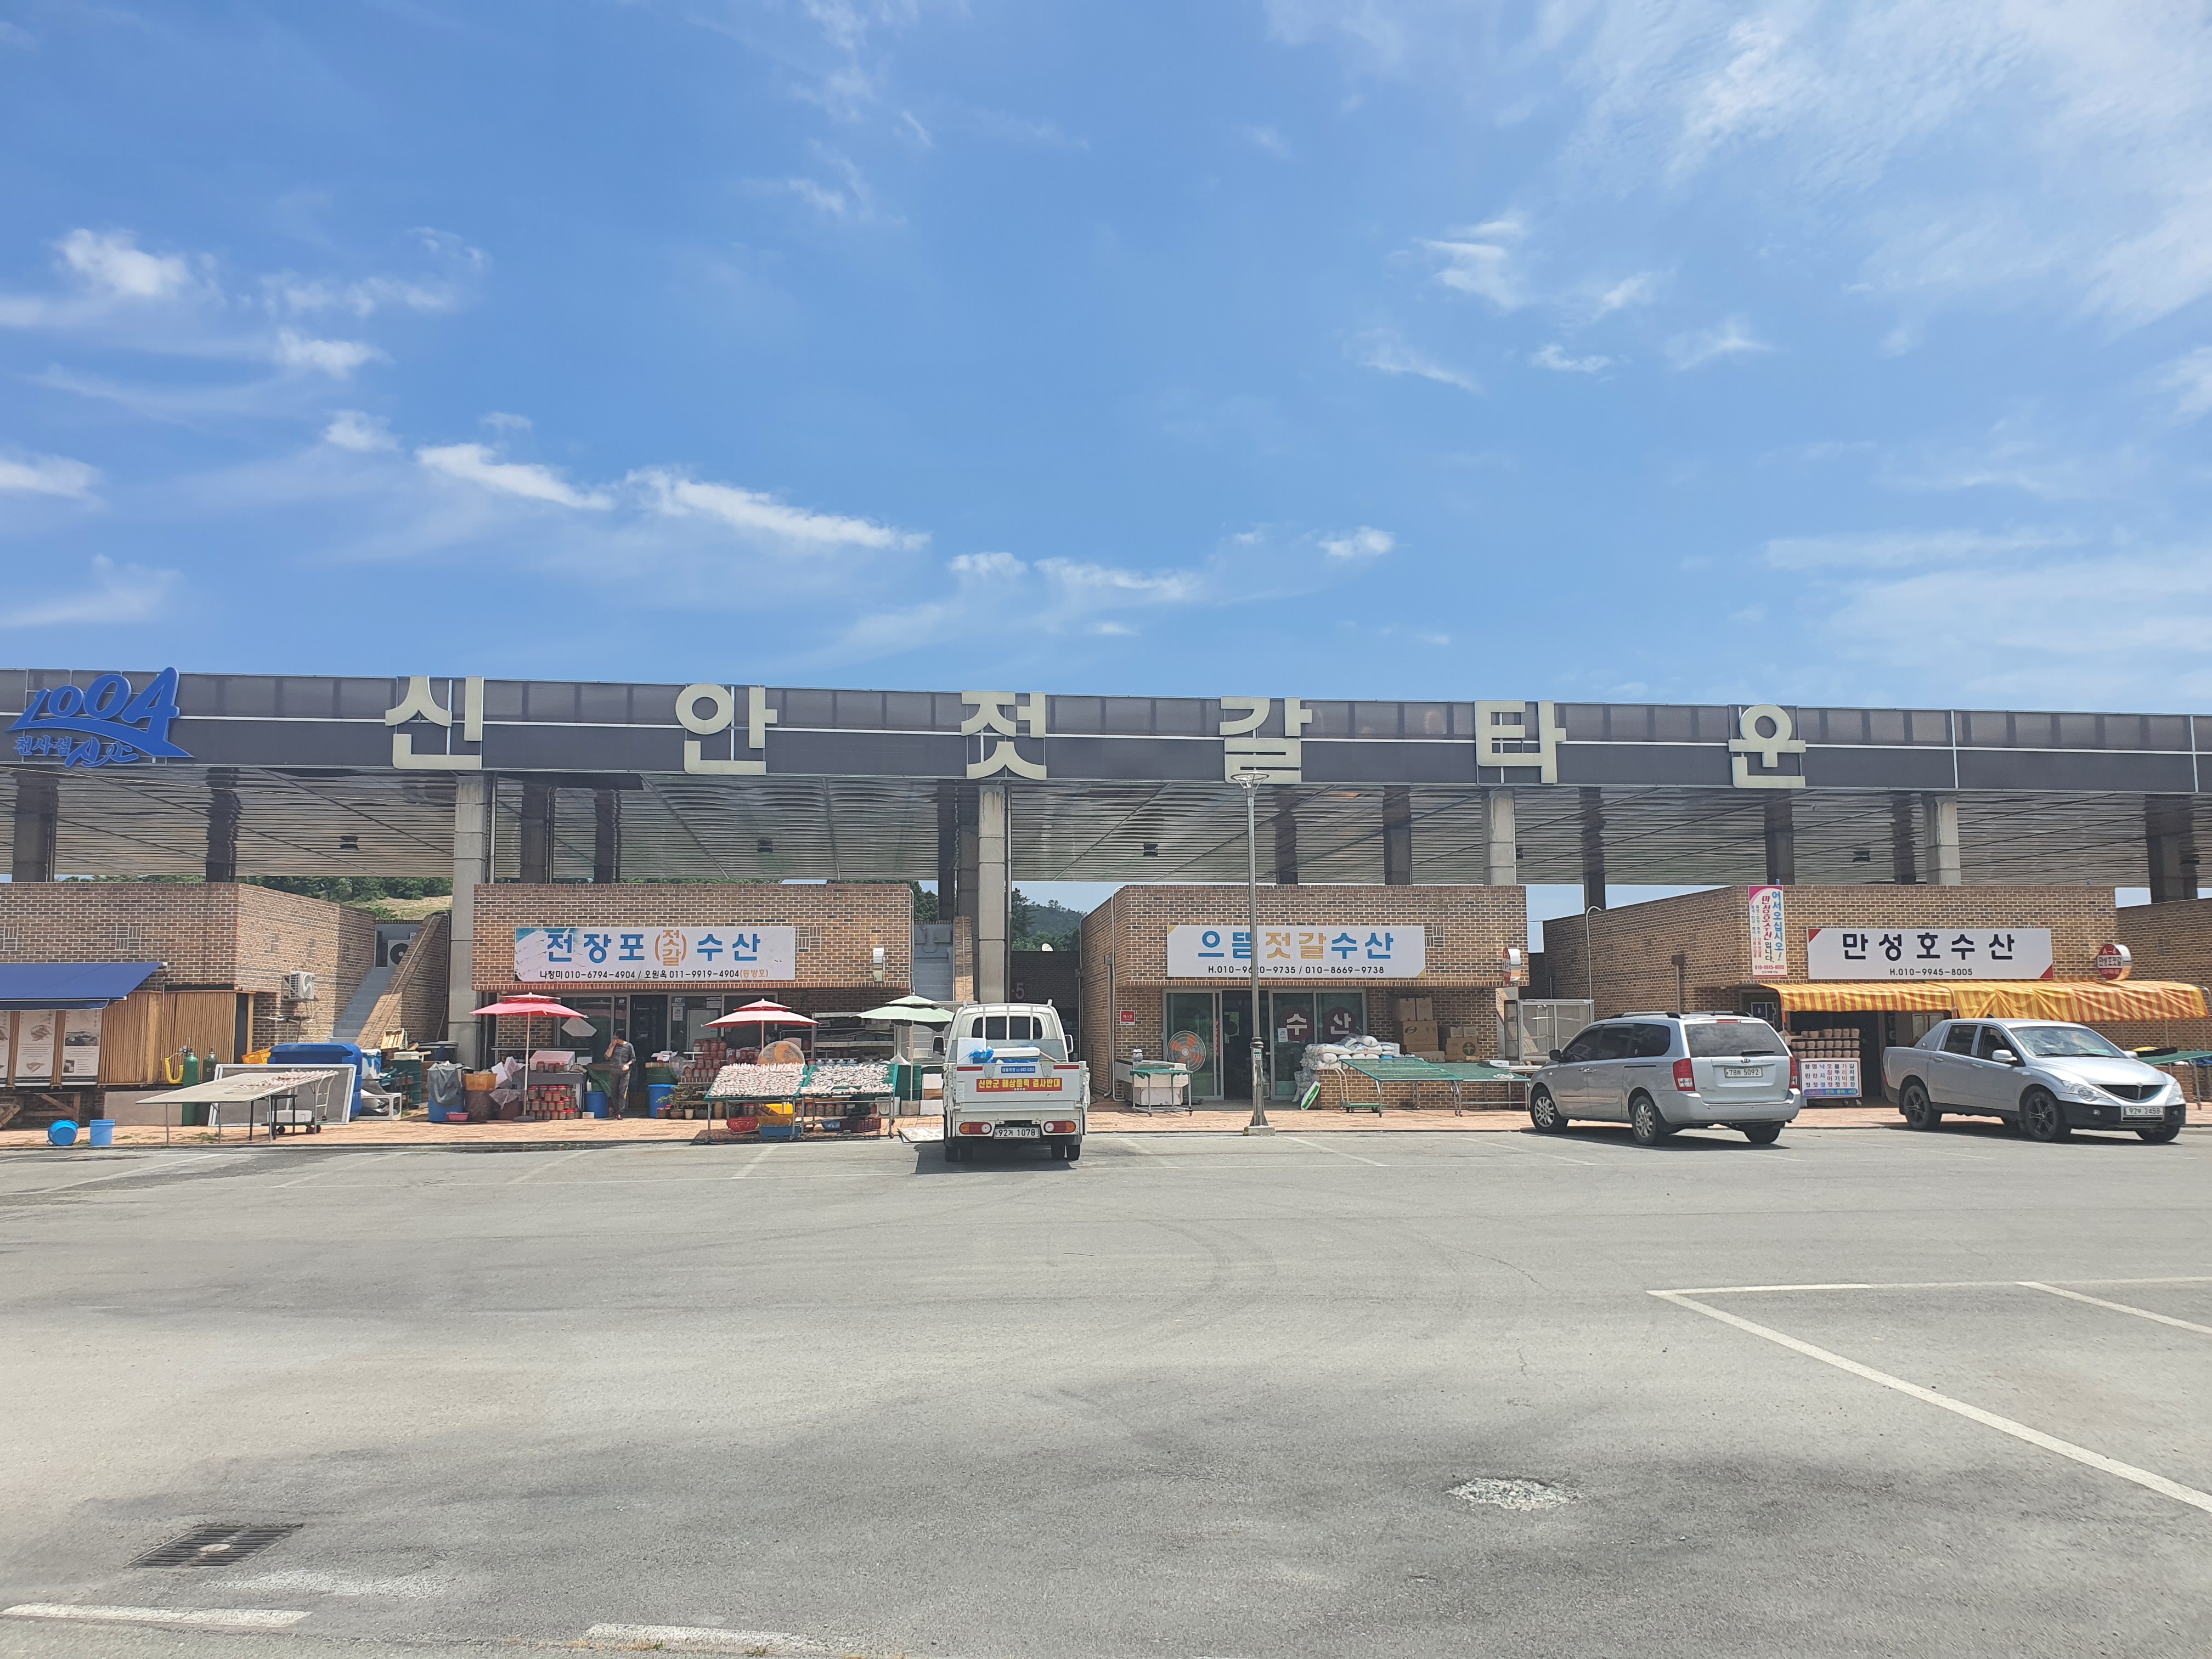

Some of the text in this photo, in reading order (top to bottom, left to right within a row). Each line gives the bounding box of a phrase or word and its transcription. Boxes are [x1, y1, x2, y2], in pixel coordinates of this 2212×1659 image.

[5, 667, 195, 759] 1004
[14, 735, 140, 768] 천사섬 신안
[1761, 895, 1775, 963] 만성호수산 입니다.
[1771, 890, 1784, 961] 어서오십시오!
[1842, 932, 2015, 961] 만성호수산
[565, 970, 635, 979] 010-6794-4904
[1208, 966, 1296, 974] H.010-960-9735
[1305, 966, 1384, 974] 010-8669-9738
[1889, 968, 1973, 976] H.010-9945-8005
[979, 1080, 1000, 1088] 신안군
